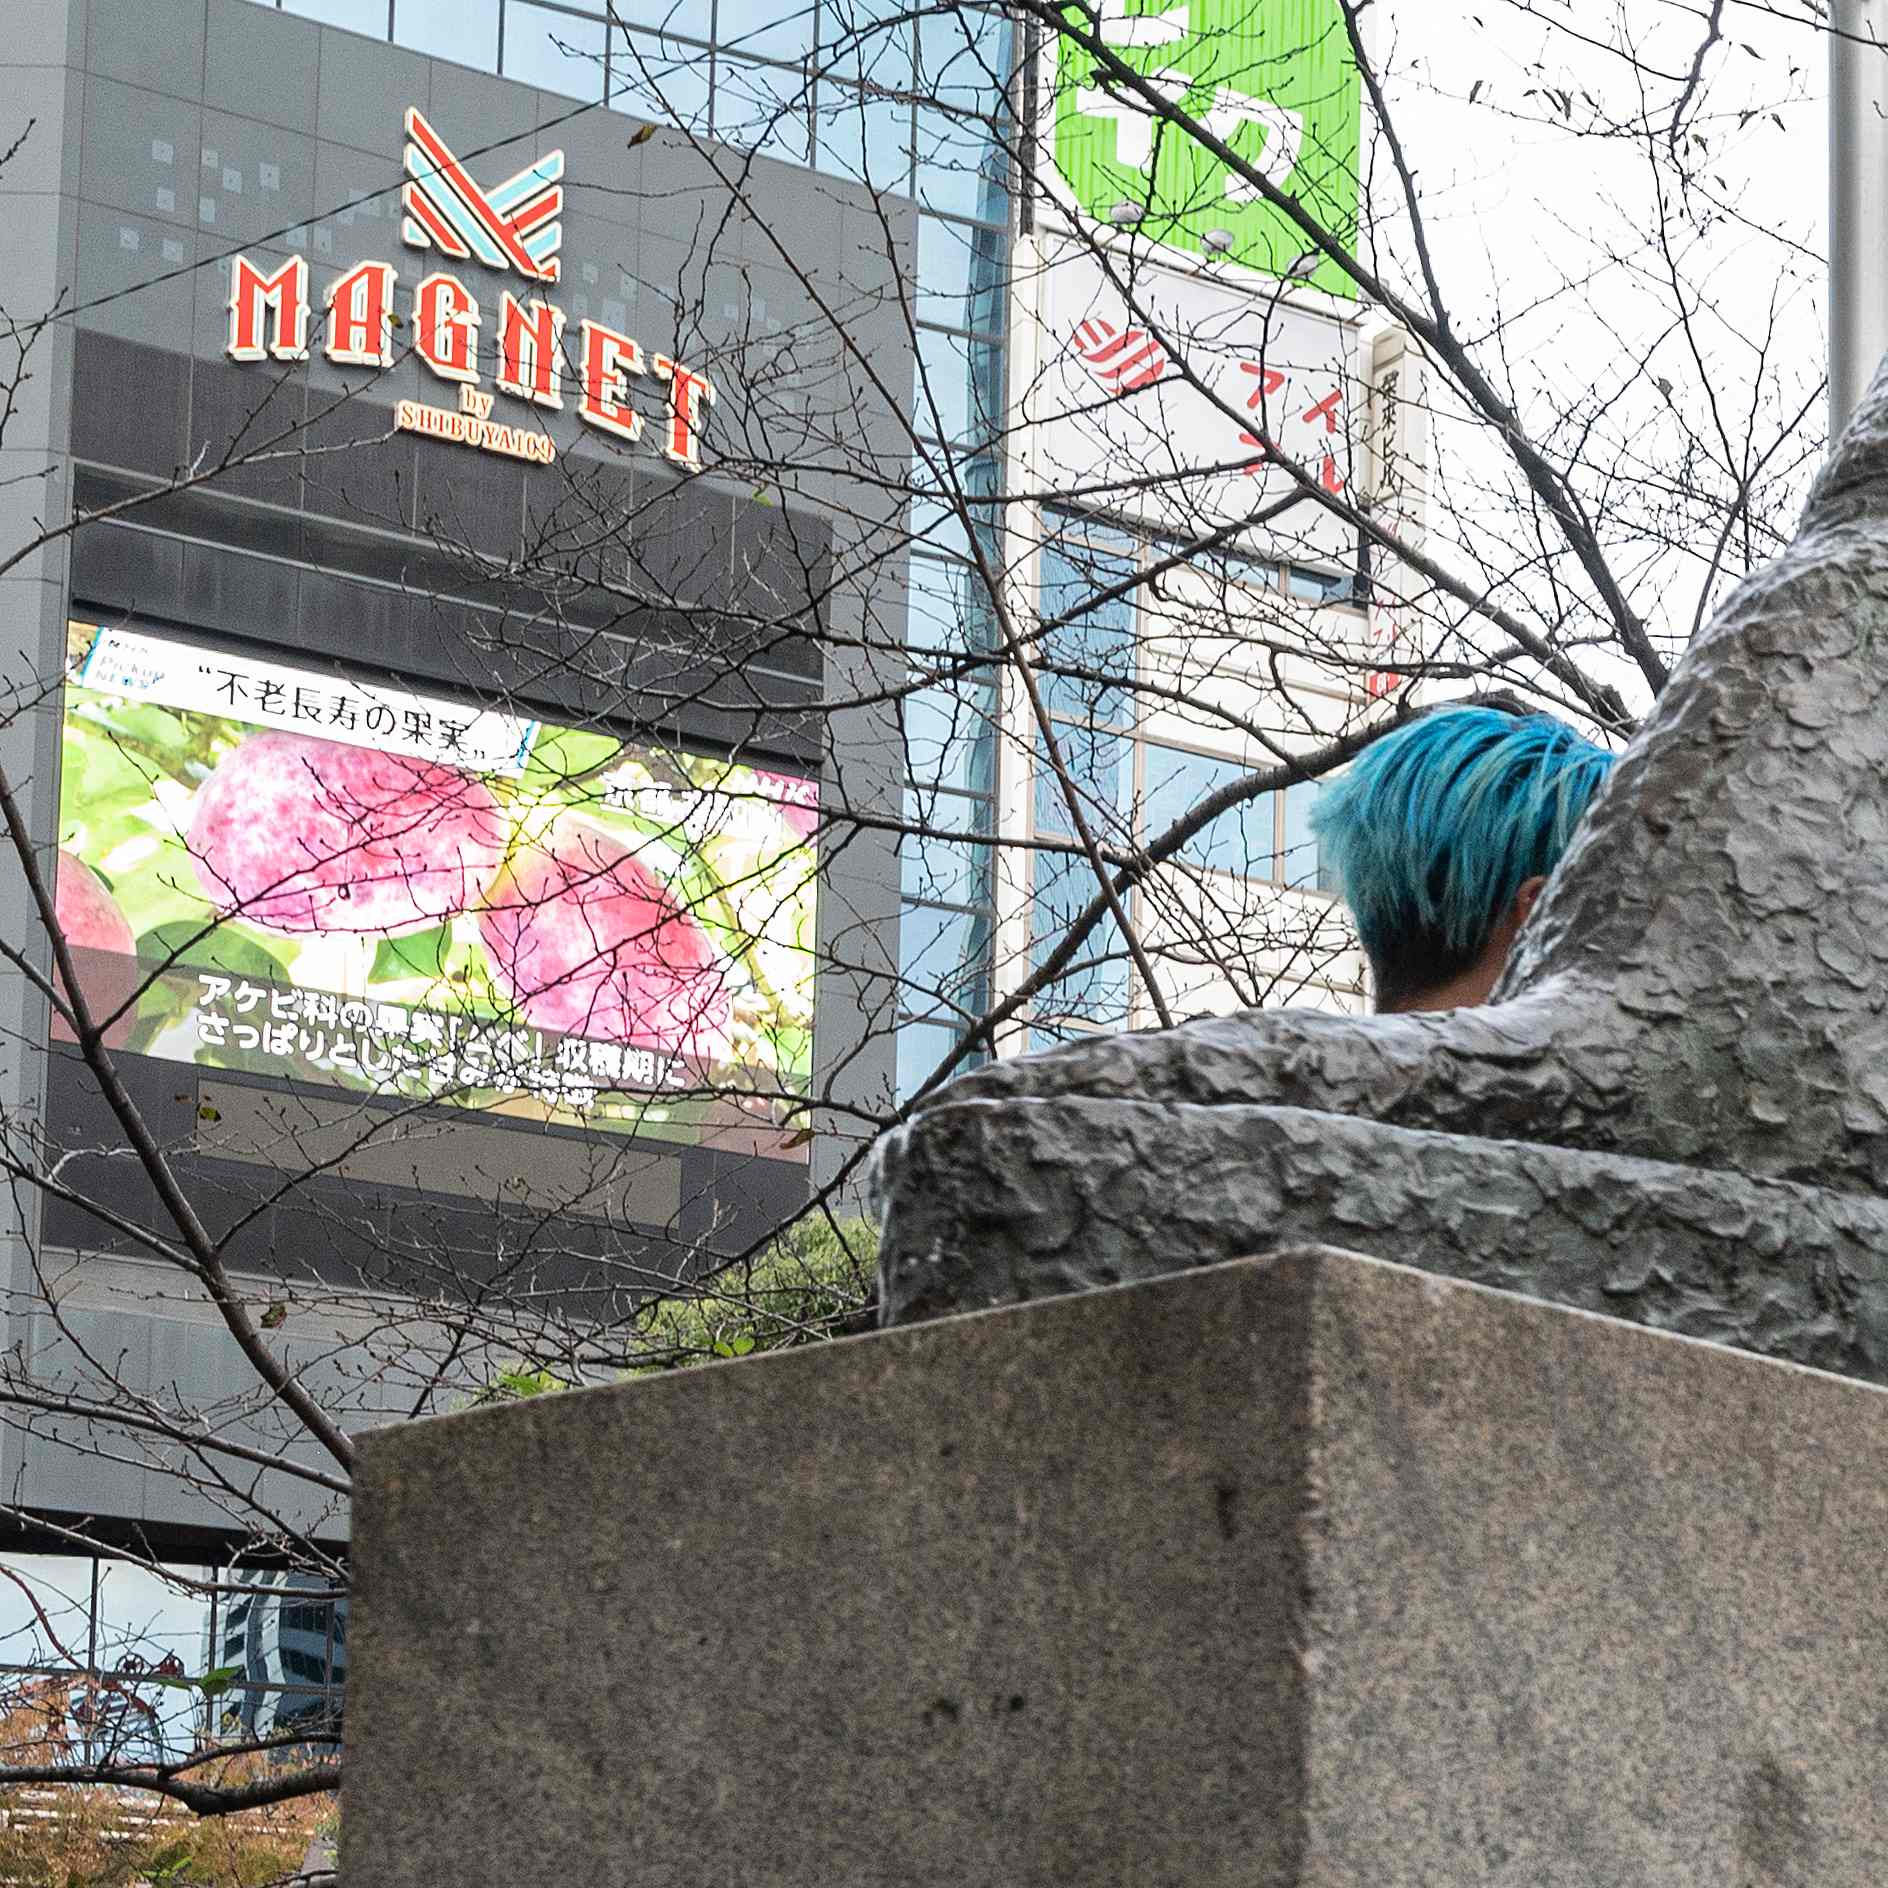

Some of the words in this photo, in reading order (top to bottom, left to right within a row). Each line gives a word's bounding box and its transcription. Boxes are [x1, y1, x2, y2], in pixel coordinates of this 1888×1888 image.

[230, 254, 717, 472] MAGNET
[394, 400, 556, 465] SHIBUYA109
[458, 384, 493, 416] by
